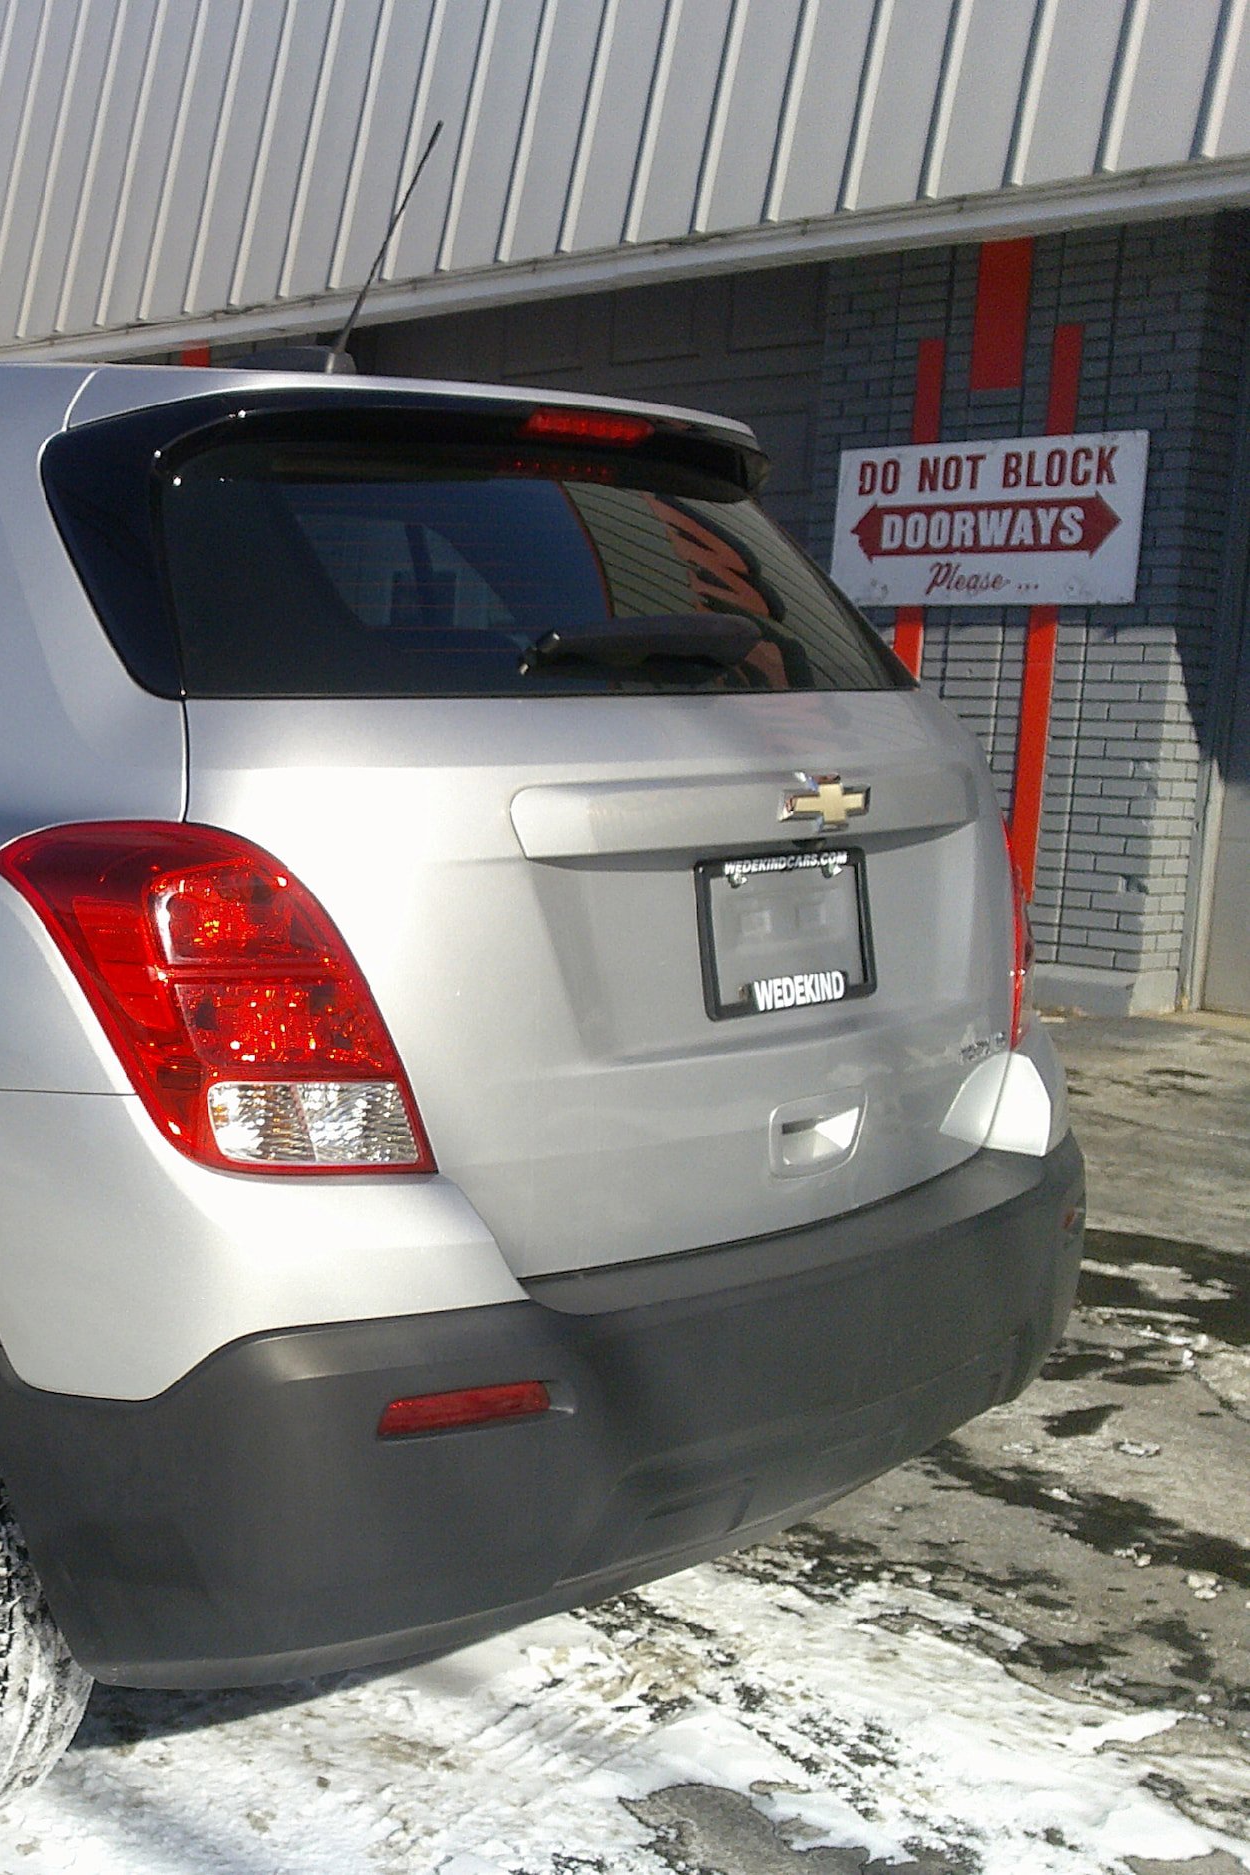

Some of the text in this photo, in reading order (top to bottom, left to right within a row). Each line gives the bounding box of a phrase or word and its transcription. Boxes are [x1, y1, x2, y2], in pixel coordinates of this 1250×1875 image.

[858, 446, 1120, 496] DO NOT BLOCK
[880, 506, 1086, 550] DOORWAYS
[925, 562, 1010, 596] Please
[724, 852, 848, 875] WEDEKINDCARS.COM
[753, 970, 846, 1012] WEDEKIND
